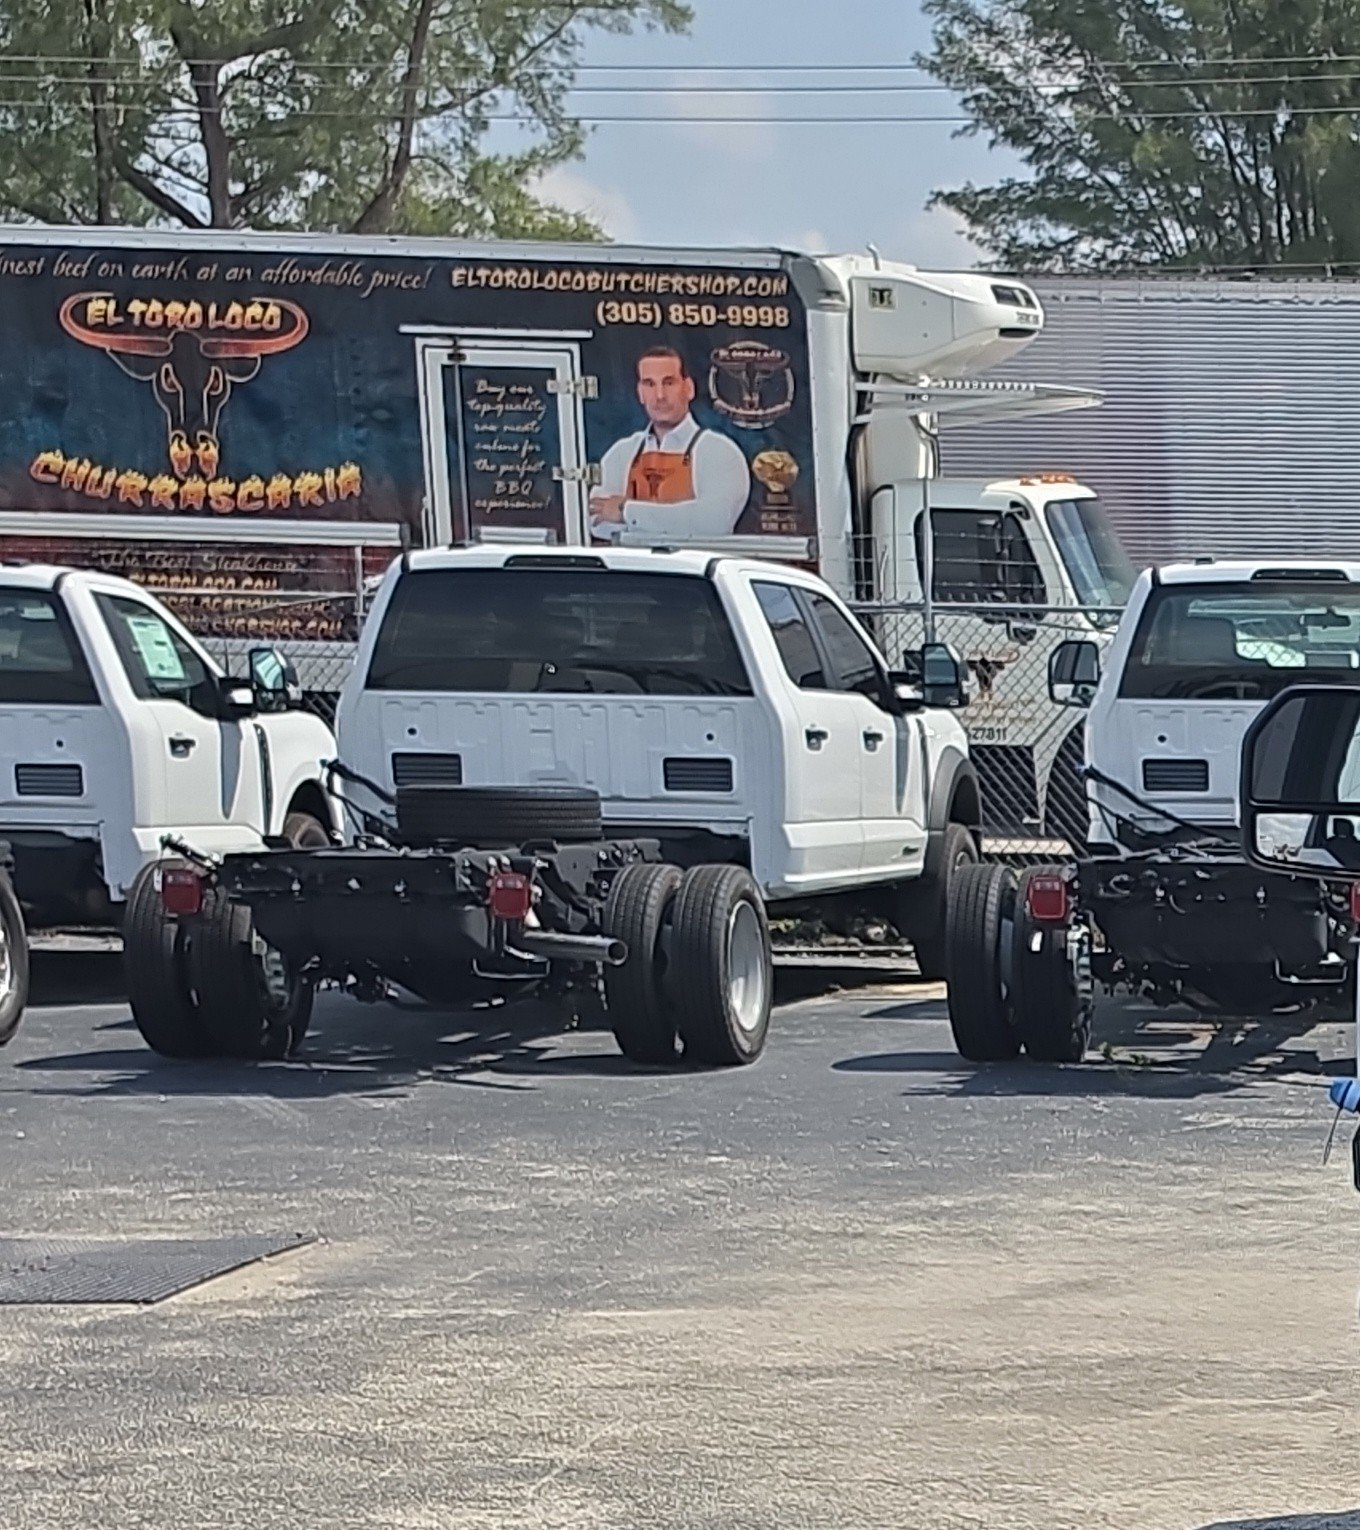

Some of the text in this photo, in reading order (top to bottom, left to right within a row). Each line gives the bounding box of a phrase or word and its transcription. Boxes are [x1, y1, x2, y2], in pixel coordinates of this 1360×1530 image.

[53, 251, 99, 278] beef
[98, 263, 124, 278] on
[132, 256, 188, 281] earth
[197, 262, 219, 281] at
[225, 265, 252, 282] an
[261, 257, 364, 288] affordable
[360, 266, 434, 299] price!
[451, 264, 788, 297] ELTOROLOCOBUTCHERSHOP.COM
[87, 298, 282, 331] EL TORO LOCO
[596, 300, 790, 328] (305) 850-9998
[29, 449, 363, 514] CHURRASCARIA
[494, 480, 533, 495] BBQ
